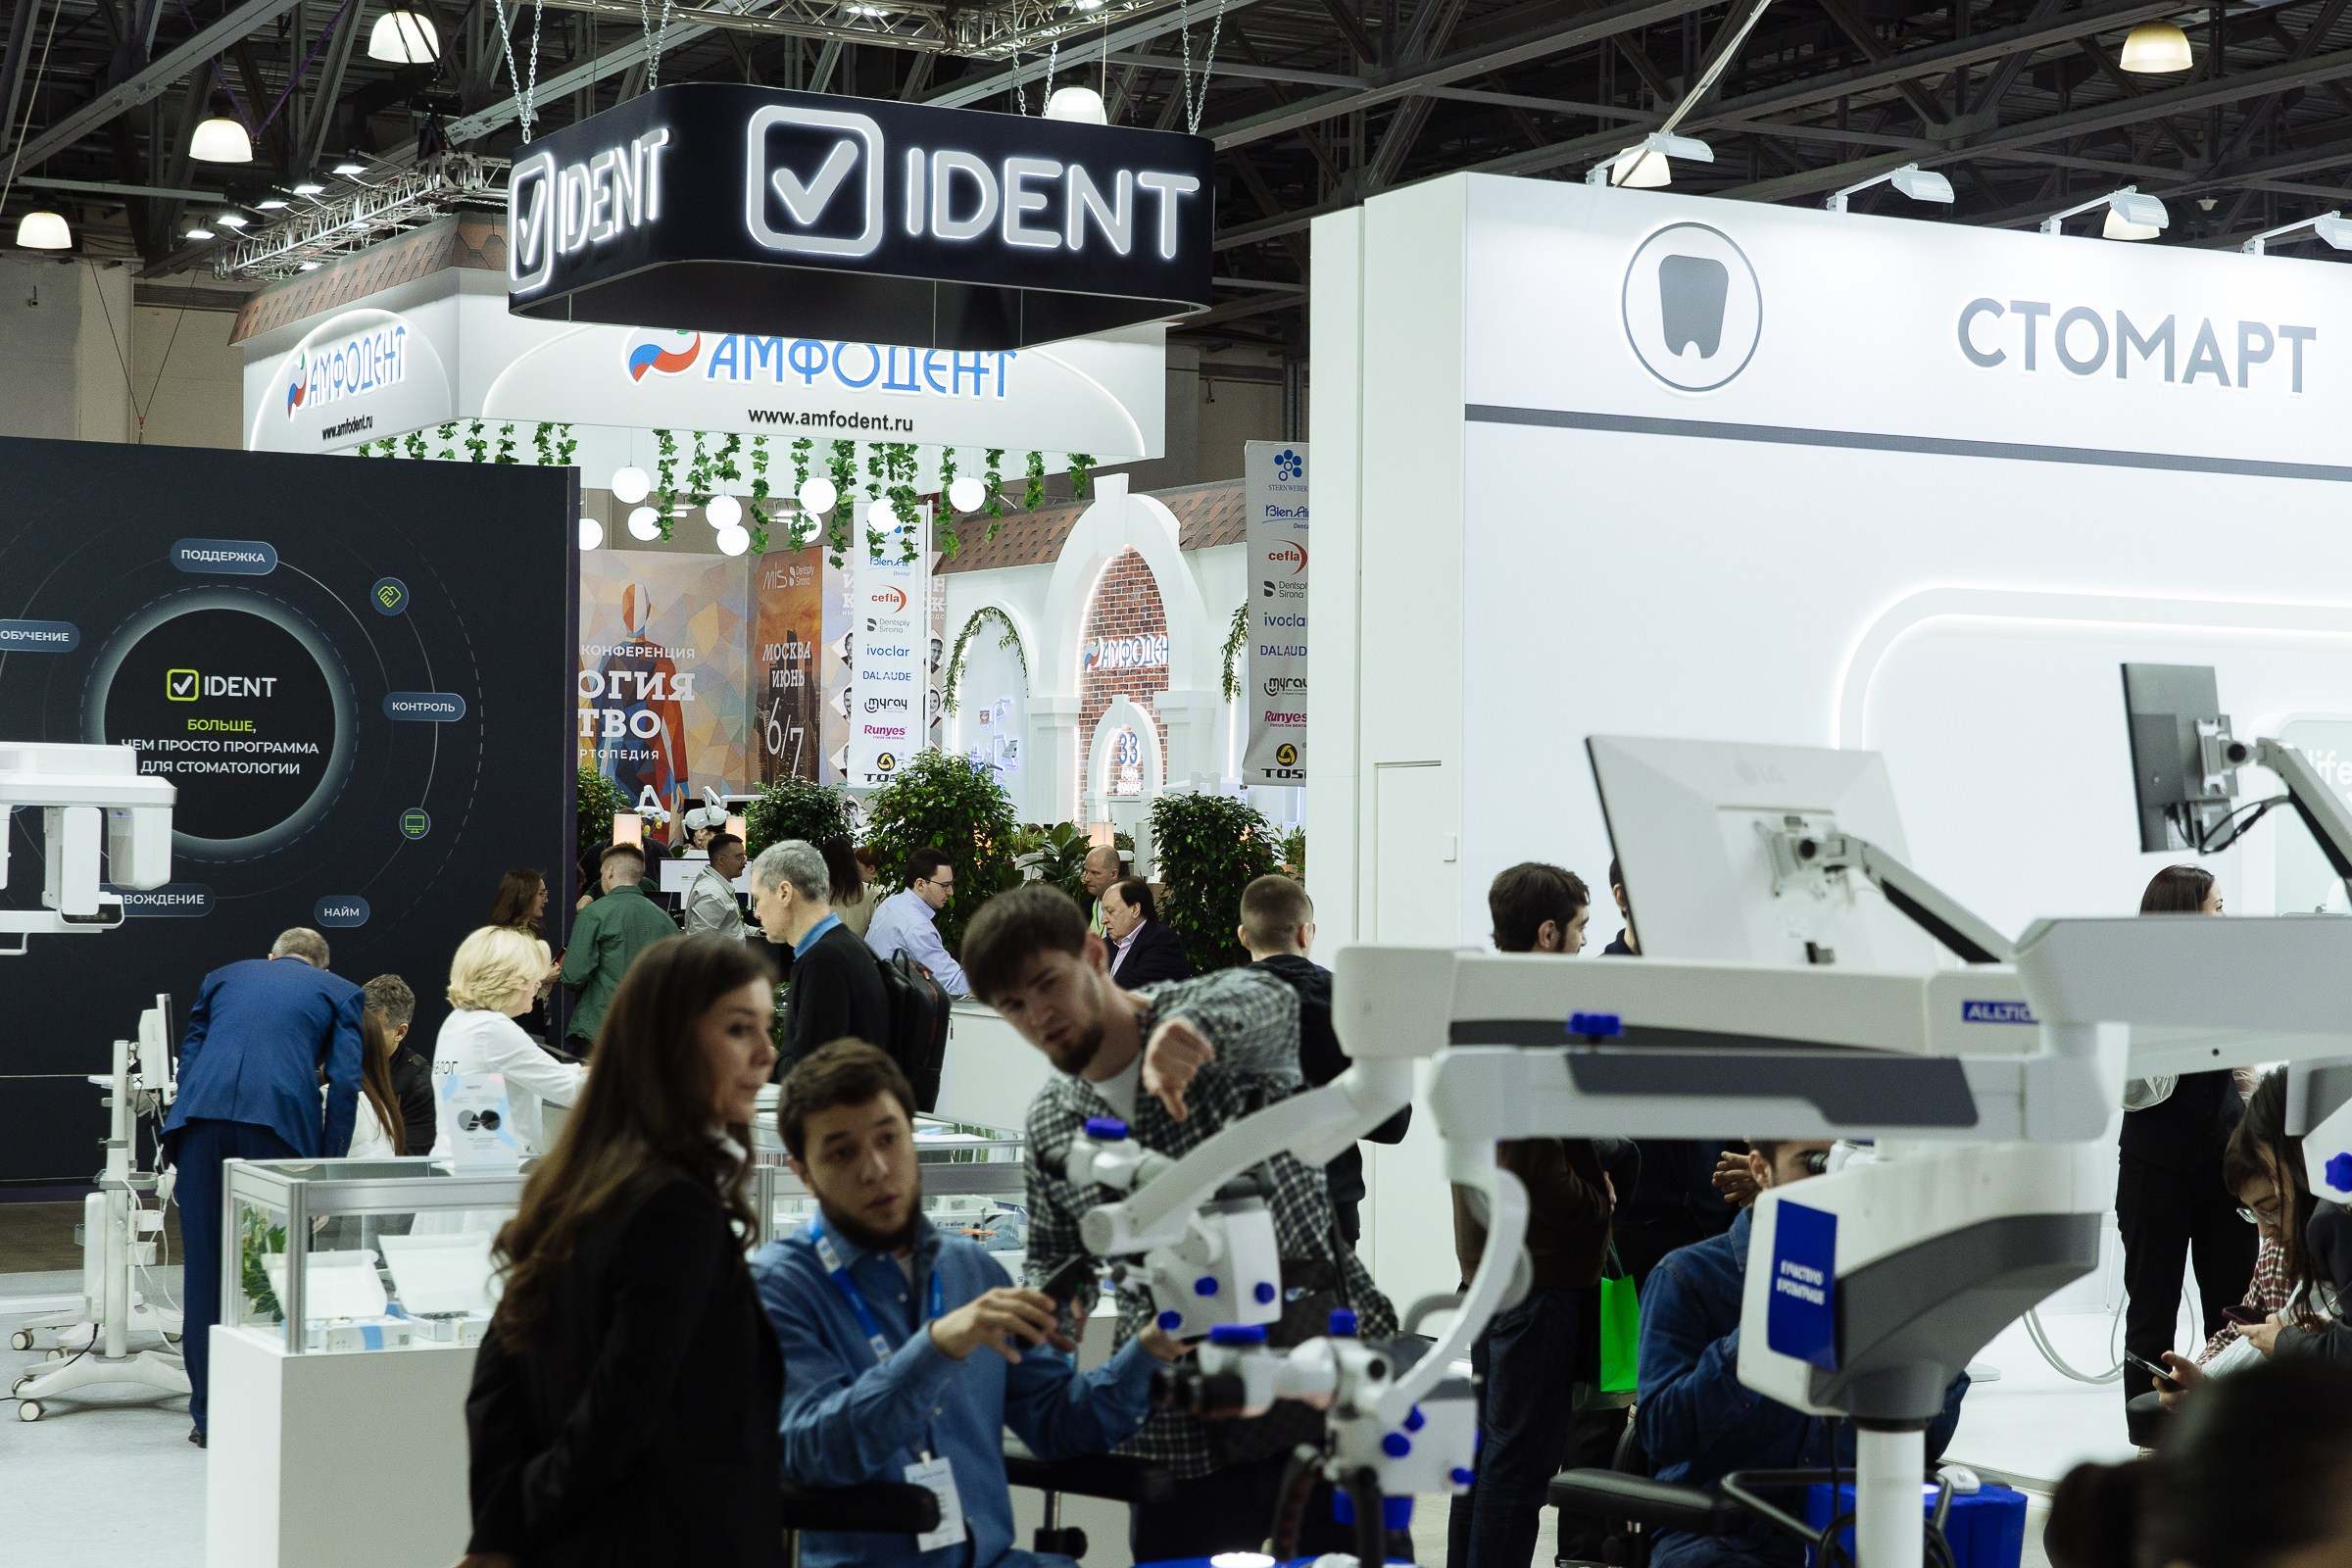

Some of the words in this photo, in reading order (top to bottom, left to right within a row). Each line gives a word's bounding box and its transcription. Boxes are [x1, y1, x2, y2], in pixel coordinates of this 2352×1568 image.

[559, 127, 668, 254] IDENT
[907, 147, 1200, 259] IDENT
[1957, 297, 2317, 393] СТОМАРТ
[310, 326, 406, 406] АМФОДЕНТ
[708, 334, 1017, 397] АМФОДЕНТ
[321, 414, 373, 441] www.amfodent.ru
[748, 409, 913, 432] www.amfodent.ru
[181, 549, 266, 564] ПОДДЕРЖКА
[1268, 550, 1299, 562] cefla
[1279, 580, 1308, 591] Dentspl
[871, 593, 900, 603] cefla
[1279, 590, 1303, 599] Sirona
[879, 617, 910, 627] Dentsply
[1264, 612, 1306, 627] ivocla
[1, 630, 70, 642] ОБУЧЕНИЕ
[581, 644, 696, 660] КОНФЕРЕНЦИЯ
[761, 641, 811, 662] МОСКВА
[866, 643, 910, 658] ivoclar
[1102, 635, 1169, 667] АМФОДЕН
[1260, 645, 1307, 657] DALAUD
[771, 668, 805, 688] ИЮНЬ
[862, 671, 911, 681] DALAUDE
[203, 676, 277, 698] IDENT
[578, 669, 696, 701] ОГИЯ
[392, 701, 456, 713] КОНТРОЛЬ
[866, 698, 907, 710] myray
[578, 708, 662, 738] ТВО
[1264, 710, 1307, 724] Runyes
[187, 718, 257, 733] БОЛЬШЕ,
[864, 724, 906, 737] Runyes
[158, 739, 220, 754] ПРОСТО
[223, 741, 319, 755] ПРОГРАММА
[1118, 732, 1138, 765] 33
[579, 749, 660, 761] РТОПЕДИЯ
[140, 760, 173, 774] ДЛЯ
[176, 760, 300, 775] СТОМАТОЛОГИИ
[1260, 768, 1306, 779] TOS
[123, 894, 205, 906] ВОЖДЕНИЕ
[323, 905, 360, 918] НАЙМ
